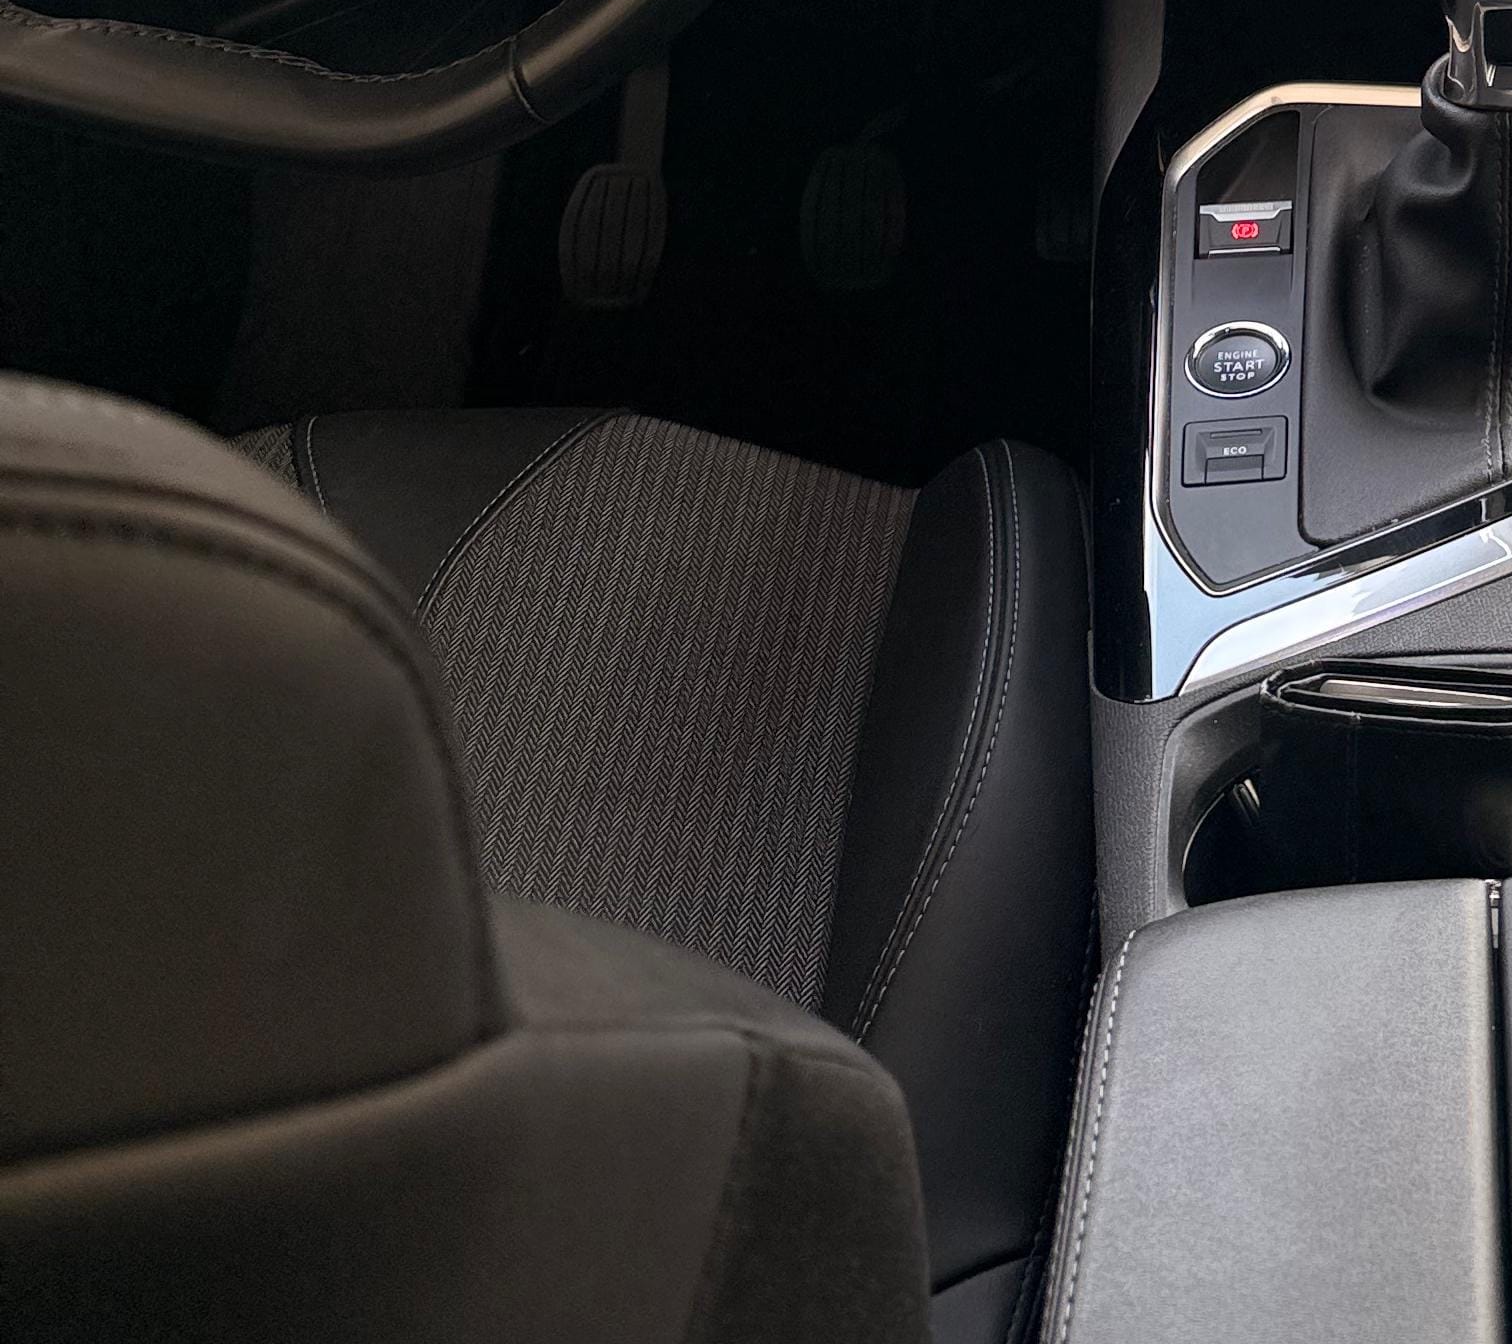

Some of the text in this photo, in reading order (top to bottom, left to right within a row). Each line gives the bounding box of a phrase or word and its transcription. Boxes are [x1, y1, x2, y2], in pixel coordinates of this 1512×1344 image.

[1217, 349, 1258, 360] ENGINE
[1214, 359, 1264, 373] START
[1220, 372, 1255, 382] STOP
[1223, 446, 1247, 456] ECO
